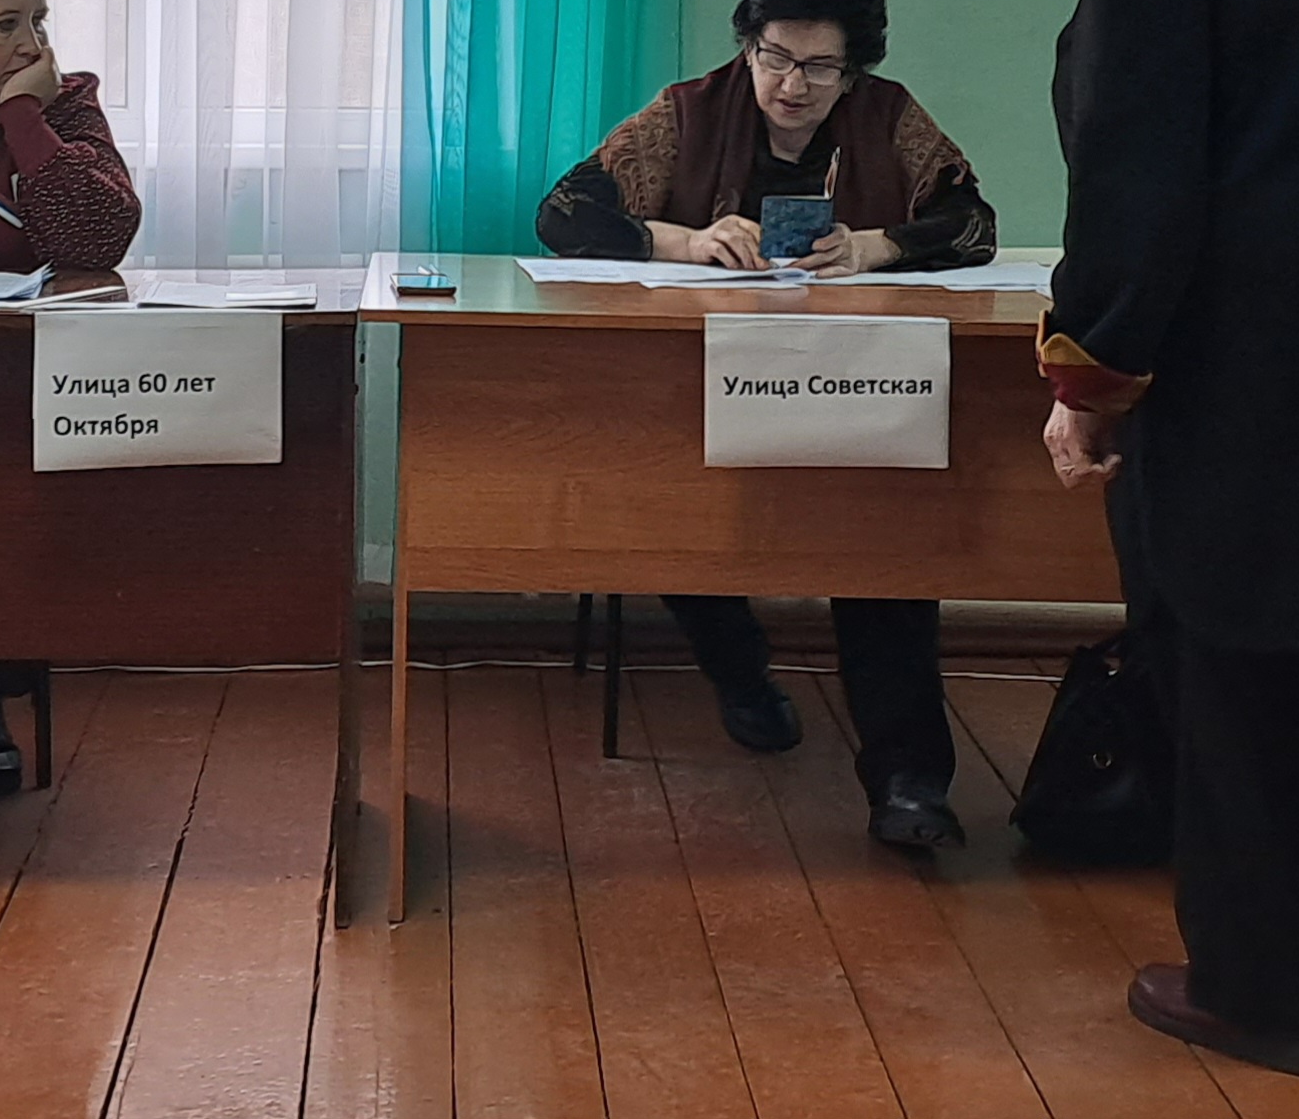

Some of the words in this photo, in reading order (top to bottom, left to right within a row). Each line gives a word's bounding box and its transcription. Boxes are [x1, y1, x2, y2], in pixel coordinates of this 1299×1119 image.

[52, 374, 131, 398] Улица
[138, 373, 167, 393] 60
[173, 376, 216, 393] лет
[723, 376, 800, 398] Улица
[807, 375, 933, 396] Советская
[54, 413, 159, 439] Октября
